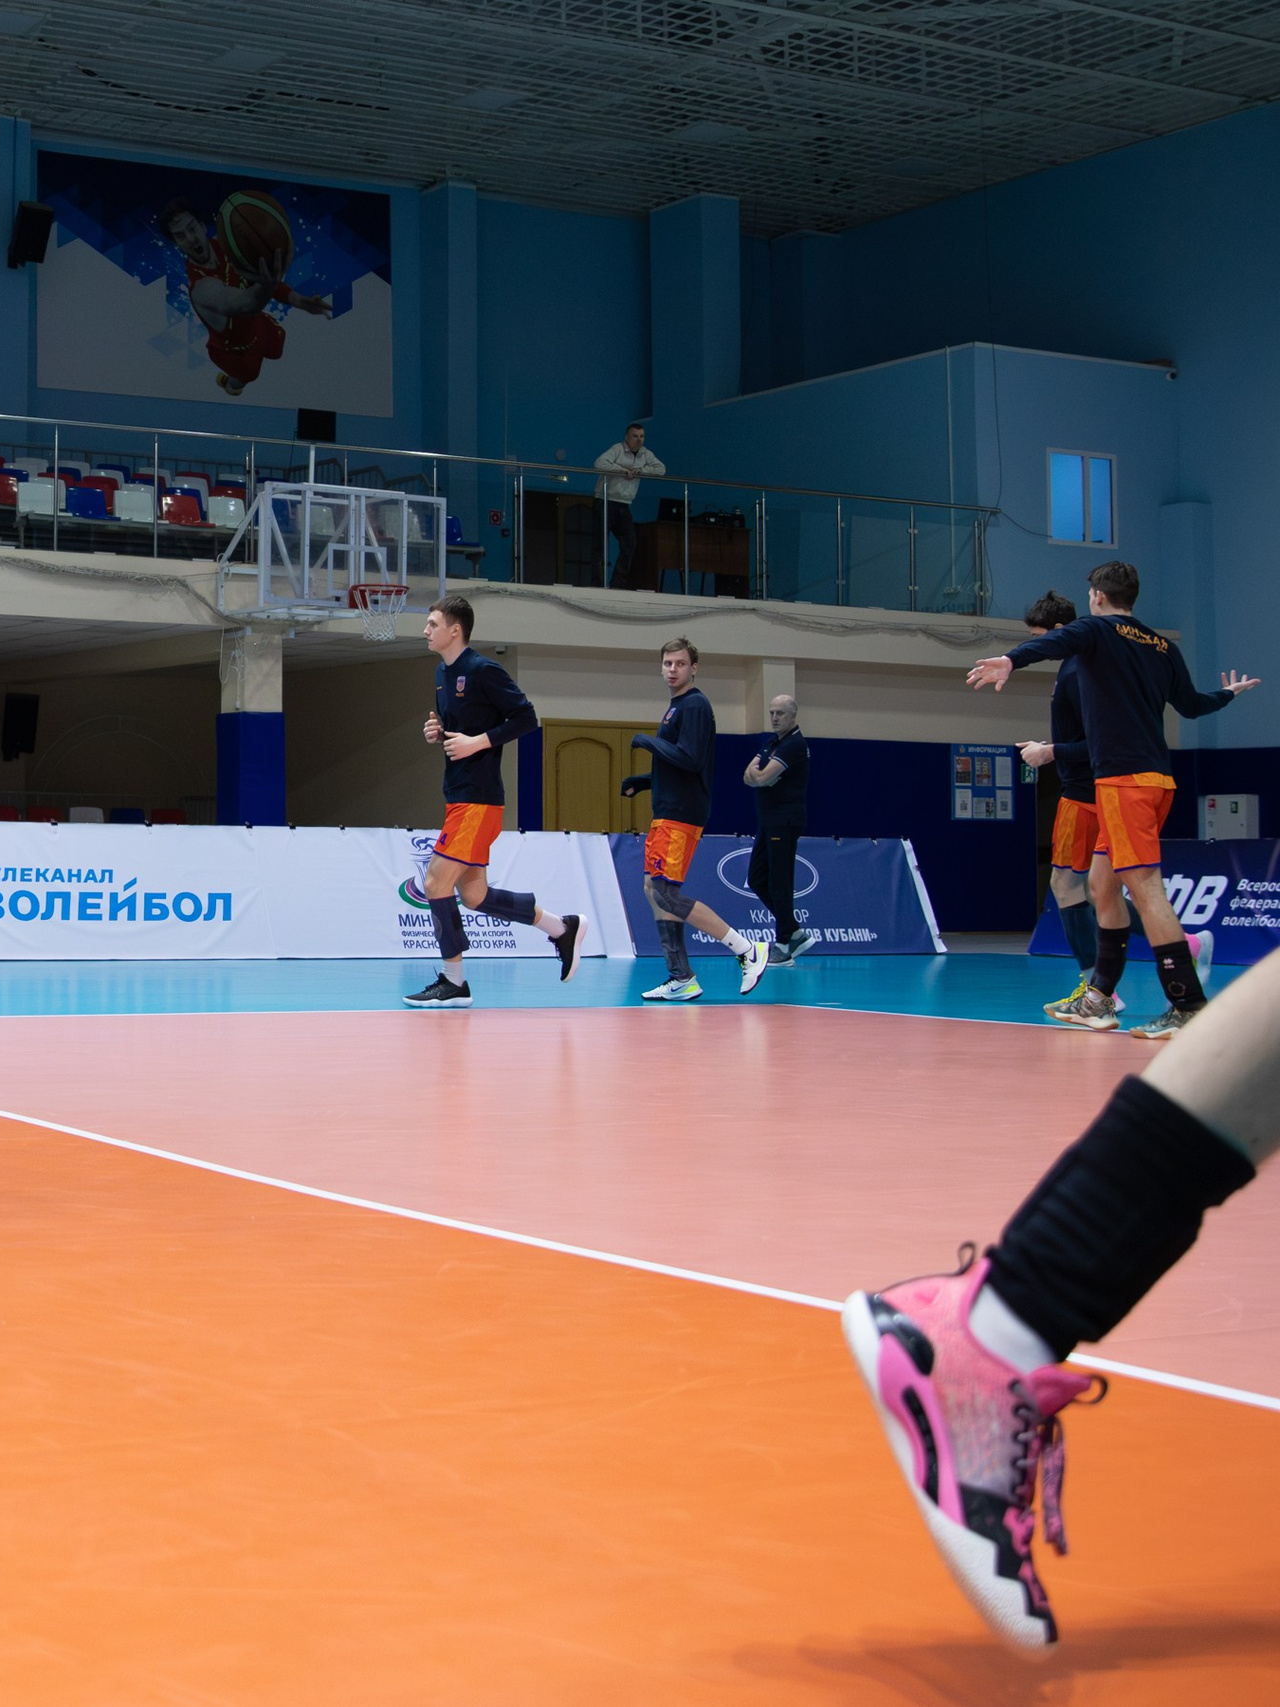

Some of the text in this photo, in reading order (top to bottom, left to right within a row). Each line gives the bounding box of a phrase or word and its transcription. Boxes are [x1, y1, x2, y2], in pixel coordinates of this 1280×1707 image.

[398, 914, 511, 928] МИНЕРСТВО
[749, 909, 809, 923] ККАОР
[824, 929, 878, 942] КУБАНИ»
[492, 940, 517, 949] КРАЯ
